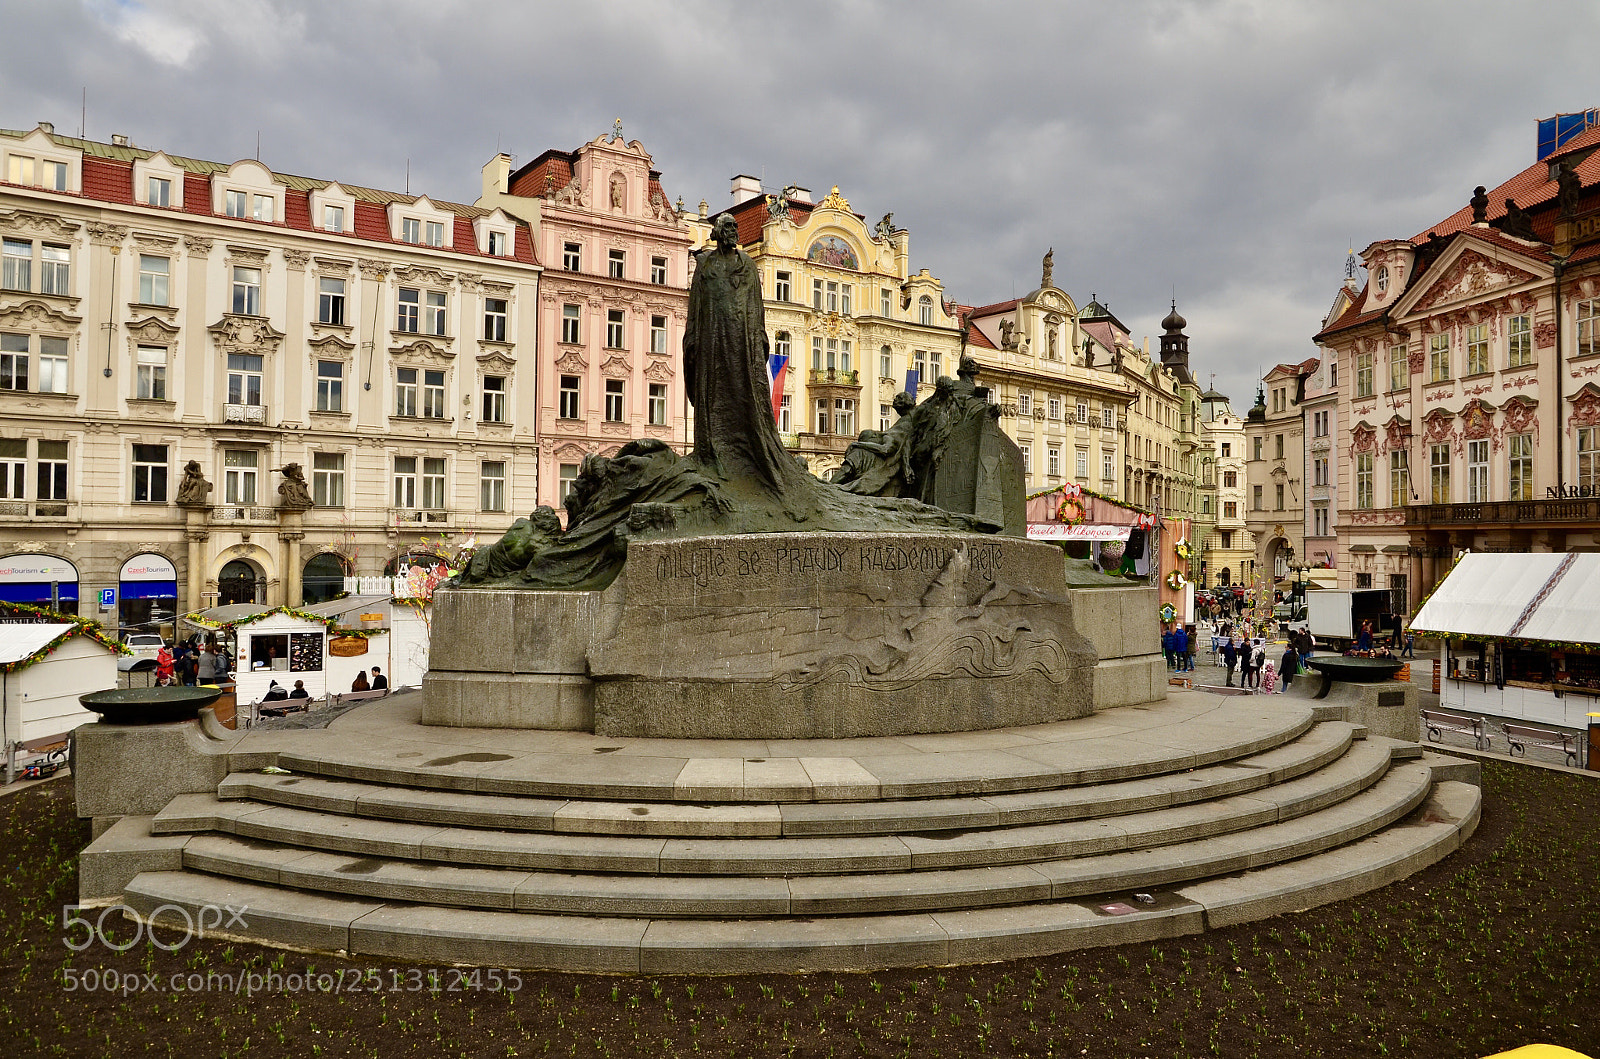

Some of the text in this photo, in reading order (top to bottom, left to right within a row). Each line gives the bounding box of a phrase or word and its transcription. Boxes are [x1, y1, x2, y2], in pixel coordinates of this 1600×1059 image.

[738, 550, 762, 575] SE
[127, 566, 170, 574] CzechTourism
[105, 590, 113, 600] P
